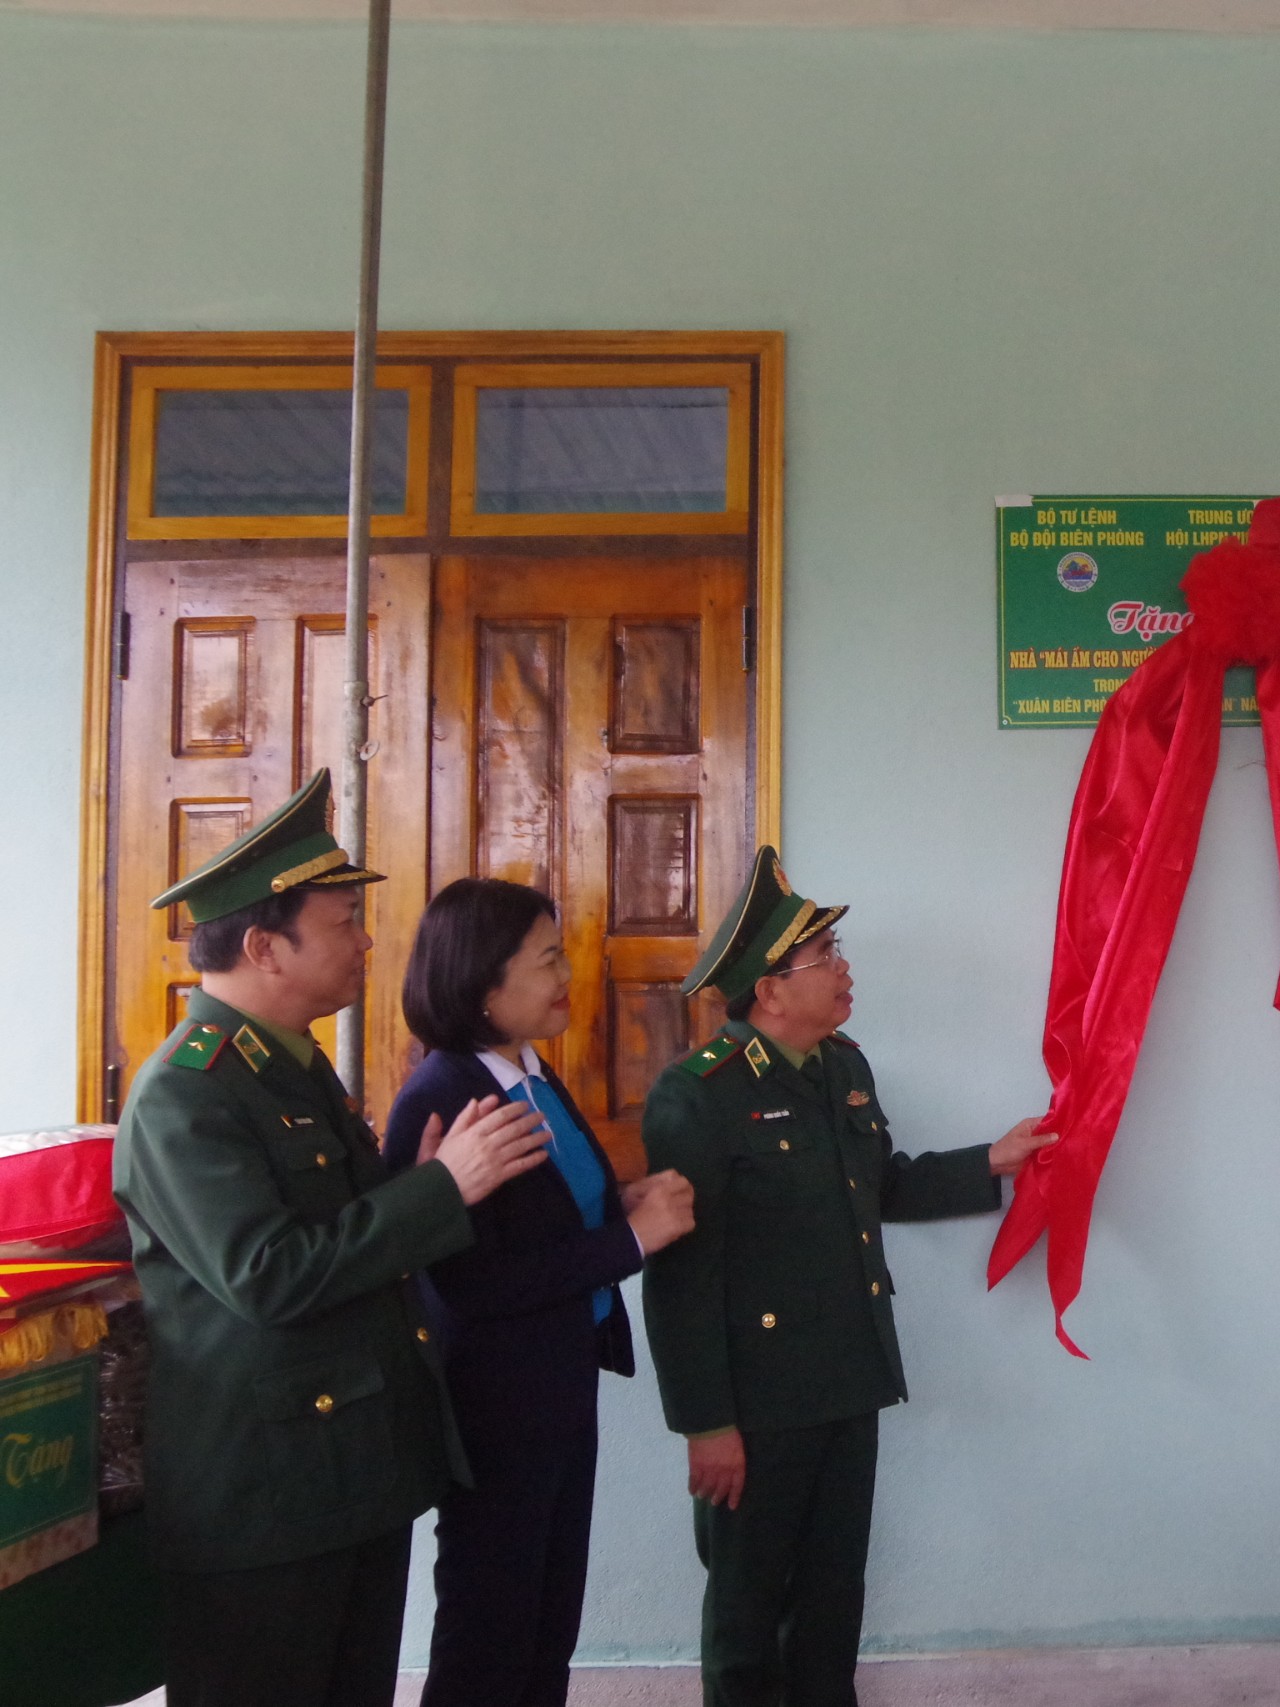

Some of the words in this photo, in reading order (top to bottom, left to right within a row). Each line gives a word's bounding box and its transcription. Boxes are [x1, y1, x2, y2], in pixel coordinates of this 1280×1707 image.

[1037, 507, 1056, 528] BỘ
[1060, 508, 1078, 525] TƯ
[1081, 507, 1117, 527] LỆNH
[1188, 509, 1233, 525] TRUNG
[1010, 529, 1029, 549] BỘ
[1033, 529, 1056, 549] ĐỘI
[1060, 529, 1093, 546] BIÊN
[1097, 528, 1145, 546] PHÒNG
[1166, 528, 1189, 549] HỘI
[1010, 647, 1037, 668] NHÀ
[1071, 646, 1091, 668] ẤM
[1093, 650, 1119, 668] CHO
[1122, 646, 1157, 668] NGƯ
[1093, 678, 1128, 693] TRON
[1053, 696, 1081, 713] BIÊN
[1084, 696, 1108, 713] PHÒ
